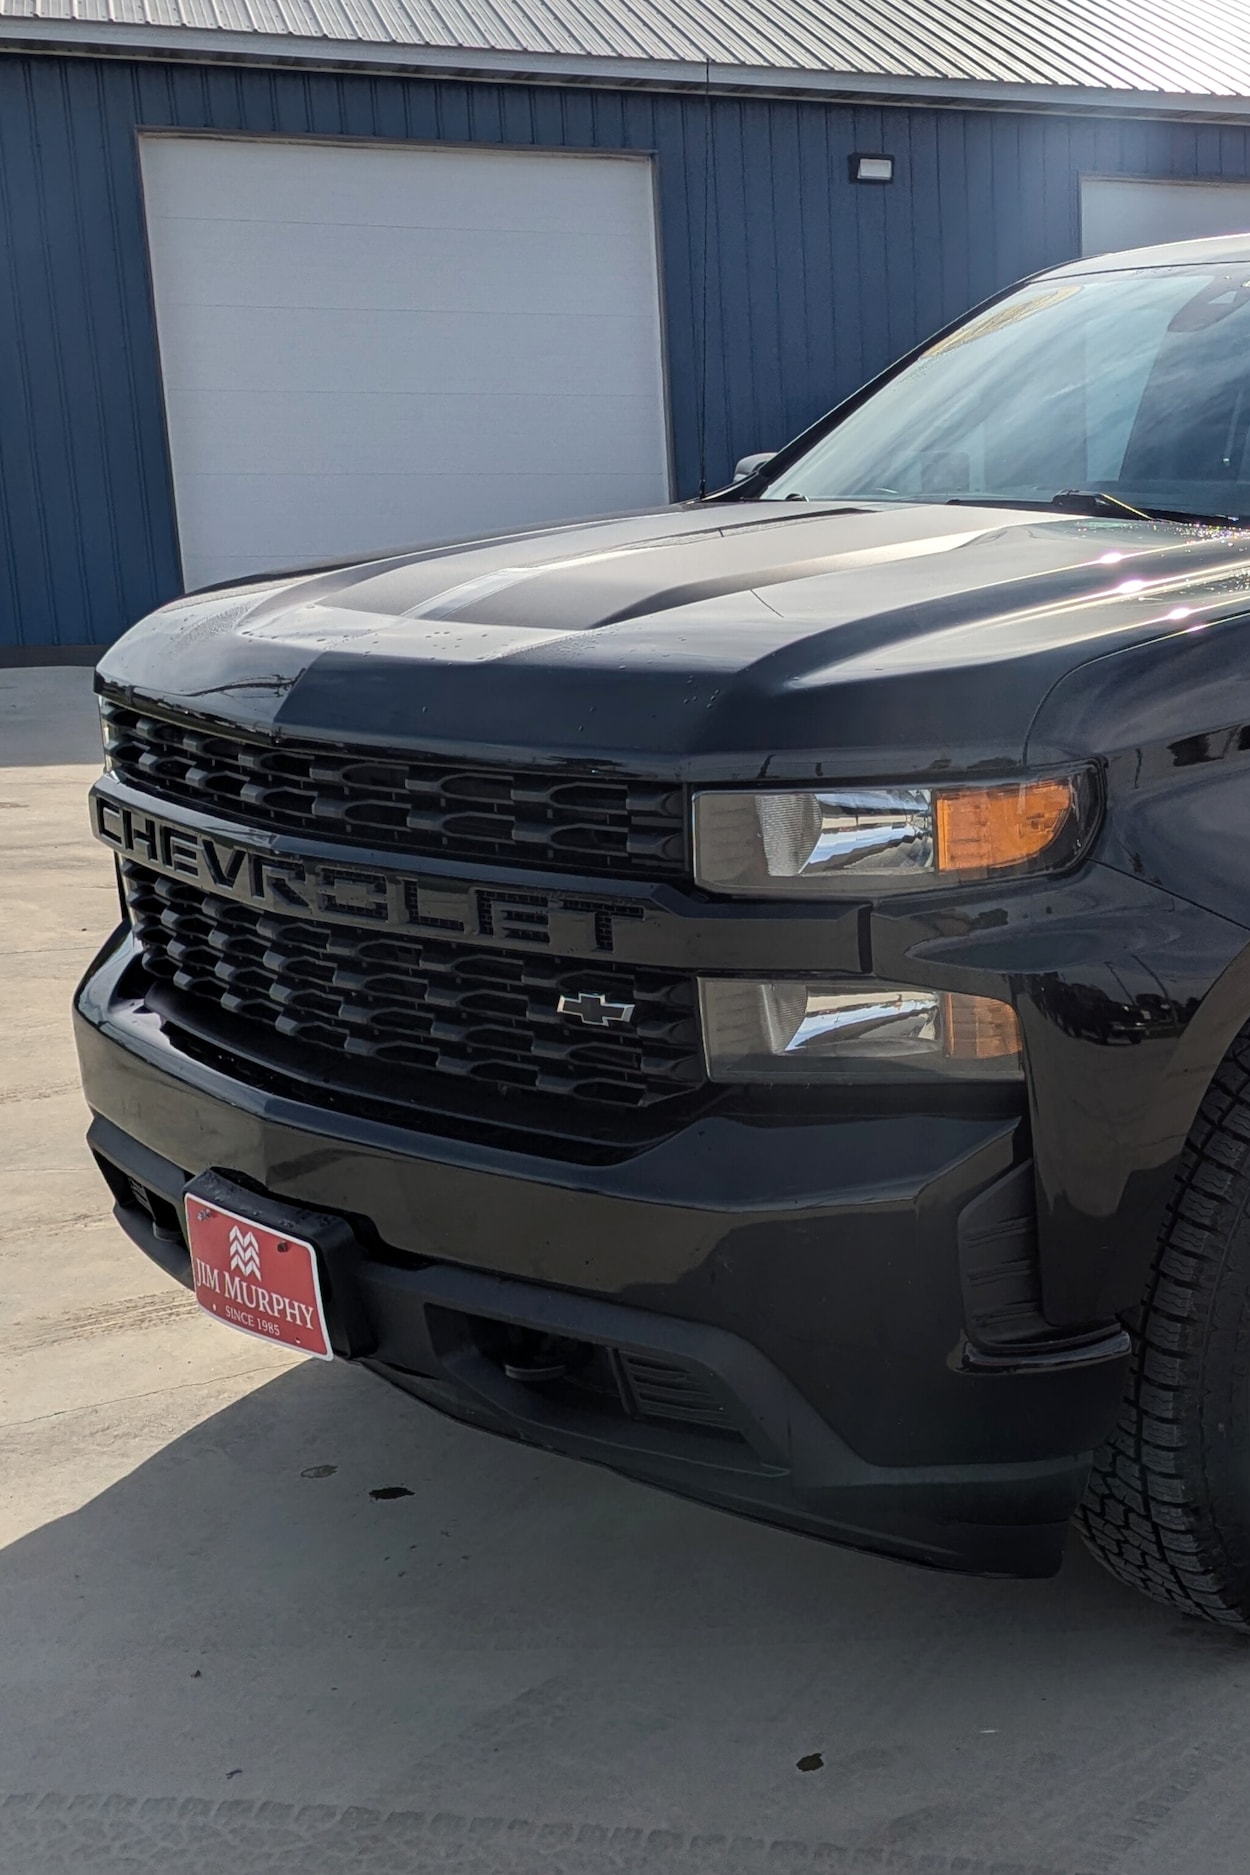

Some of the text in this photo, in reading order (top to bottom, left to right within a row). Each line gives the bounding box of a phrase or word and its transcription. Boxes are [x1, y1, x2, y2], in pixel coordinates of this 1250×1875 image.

[96, 795, 646, 953] CHEVROLET
[195, 1257, 315, 1330] JIM MURPHY
[224, 1305, 281, 1337] SINCE 1985
